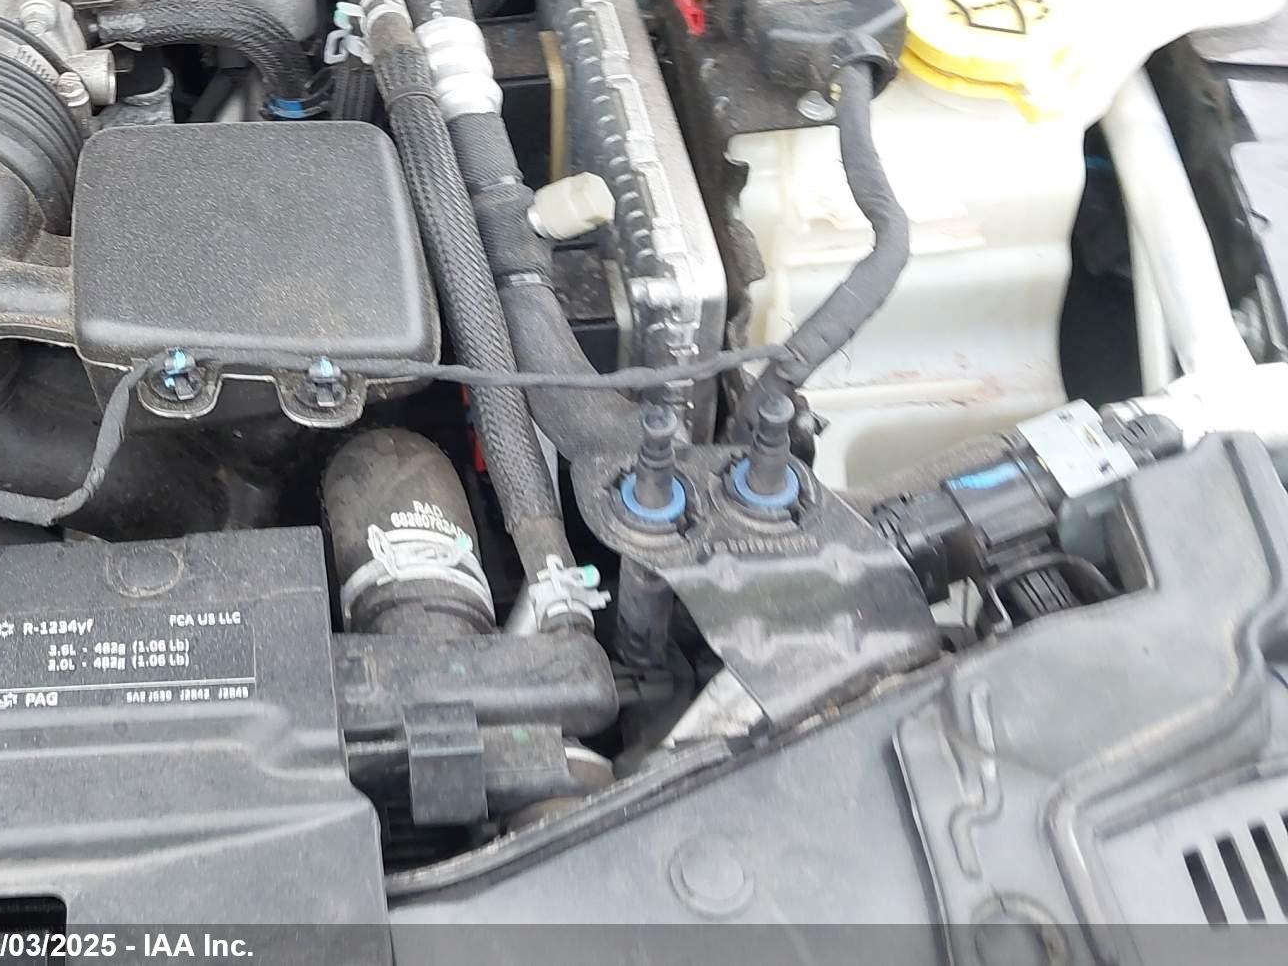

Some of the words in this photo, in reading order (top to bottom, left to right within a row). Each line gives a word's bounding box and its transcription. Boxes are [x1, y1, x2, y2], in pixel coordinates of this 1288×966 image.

[412, 500, 444, 519] RAD
[23, 619, 94, 636] R-1234yf
[169, 614, 195, 627] FCA
[218, 611, 241, 625] LLC
[25, 691, 59, 707] PAG
